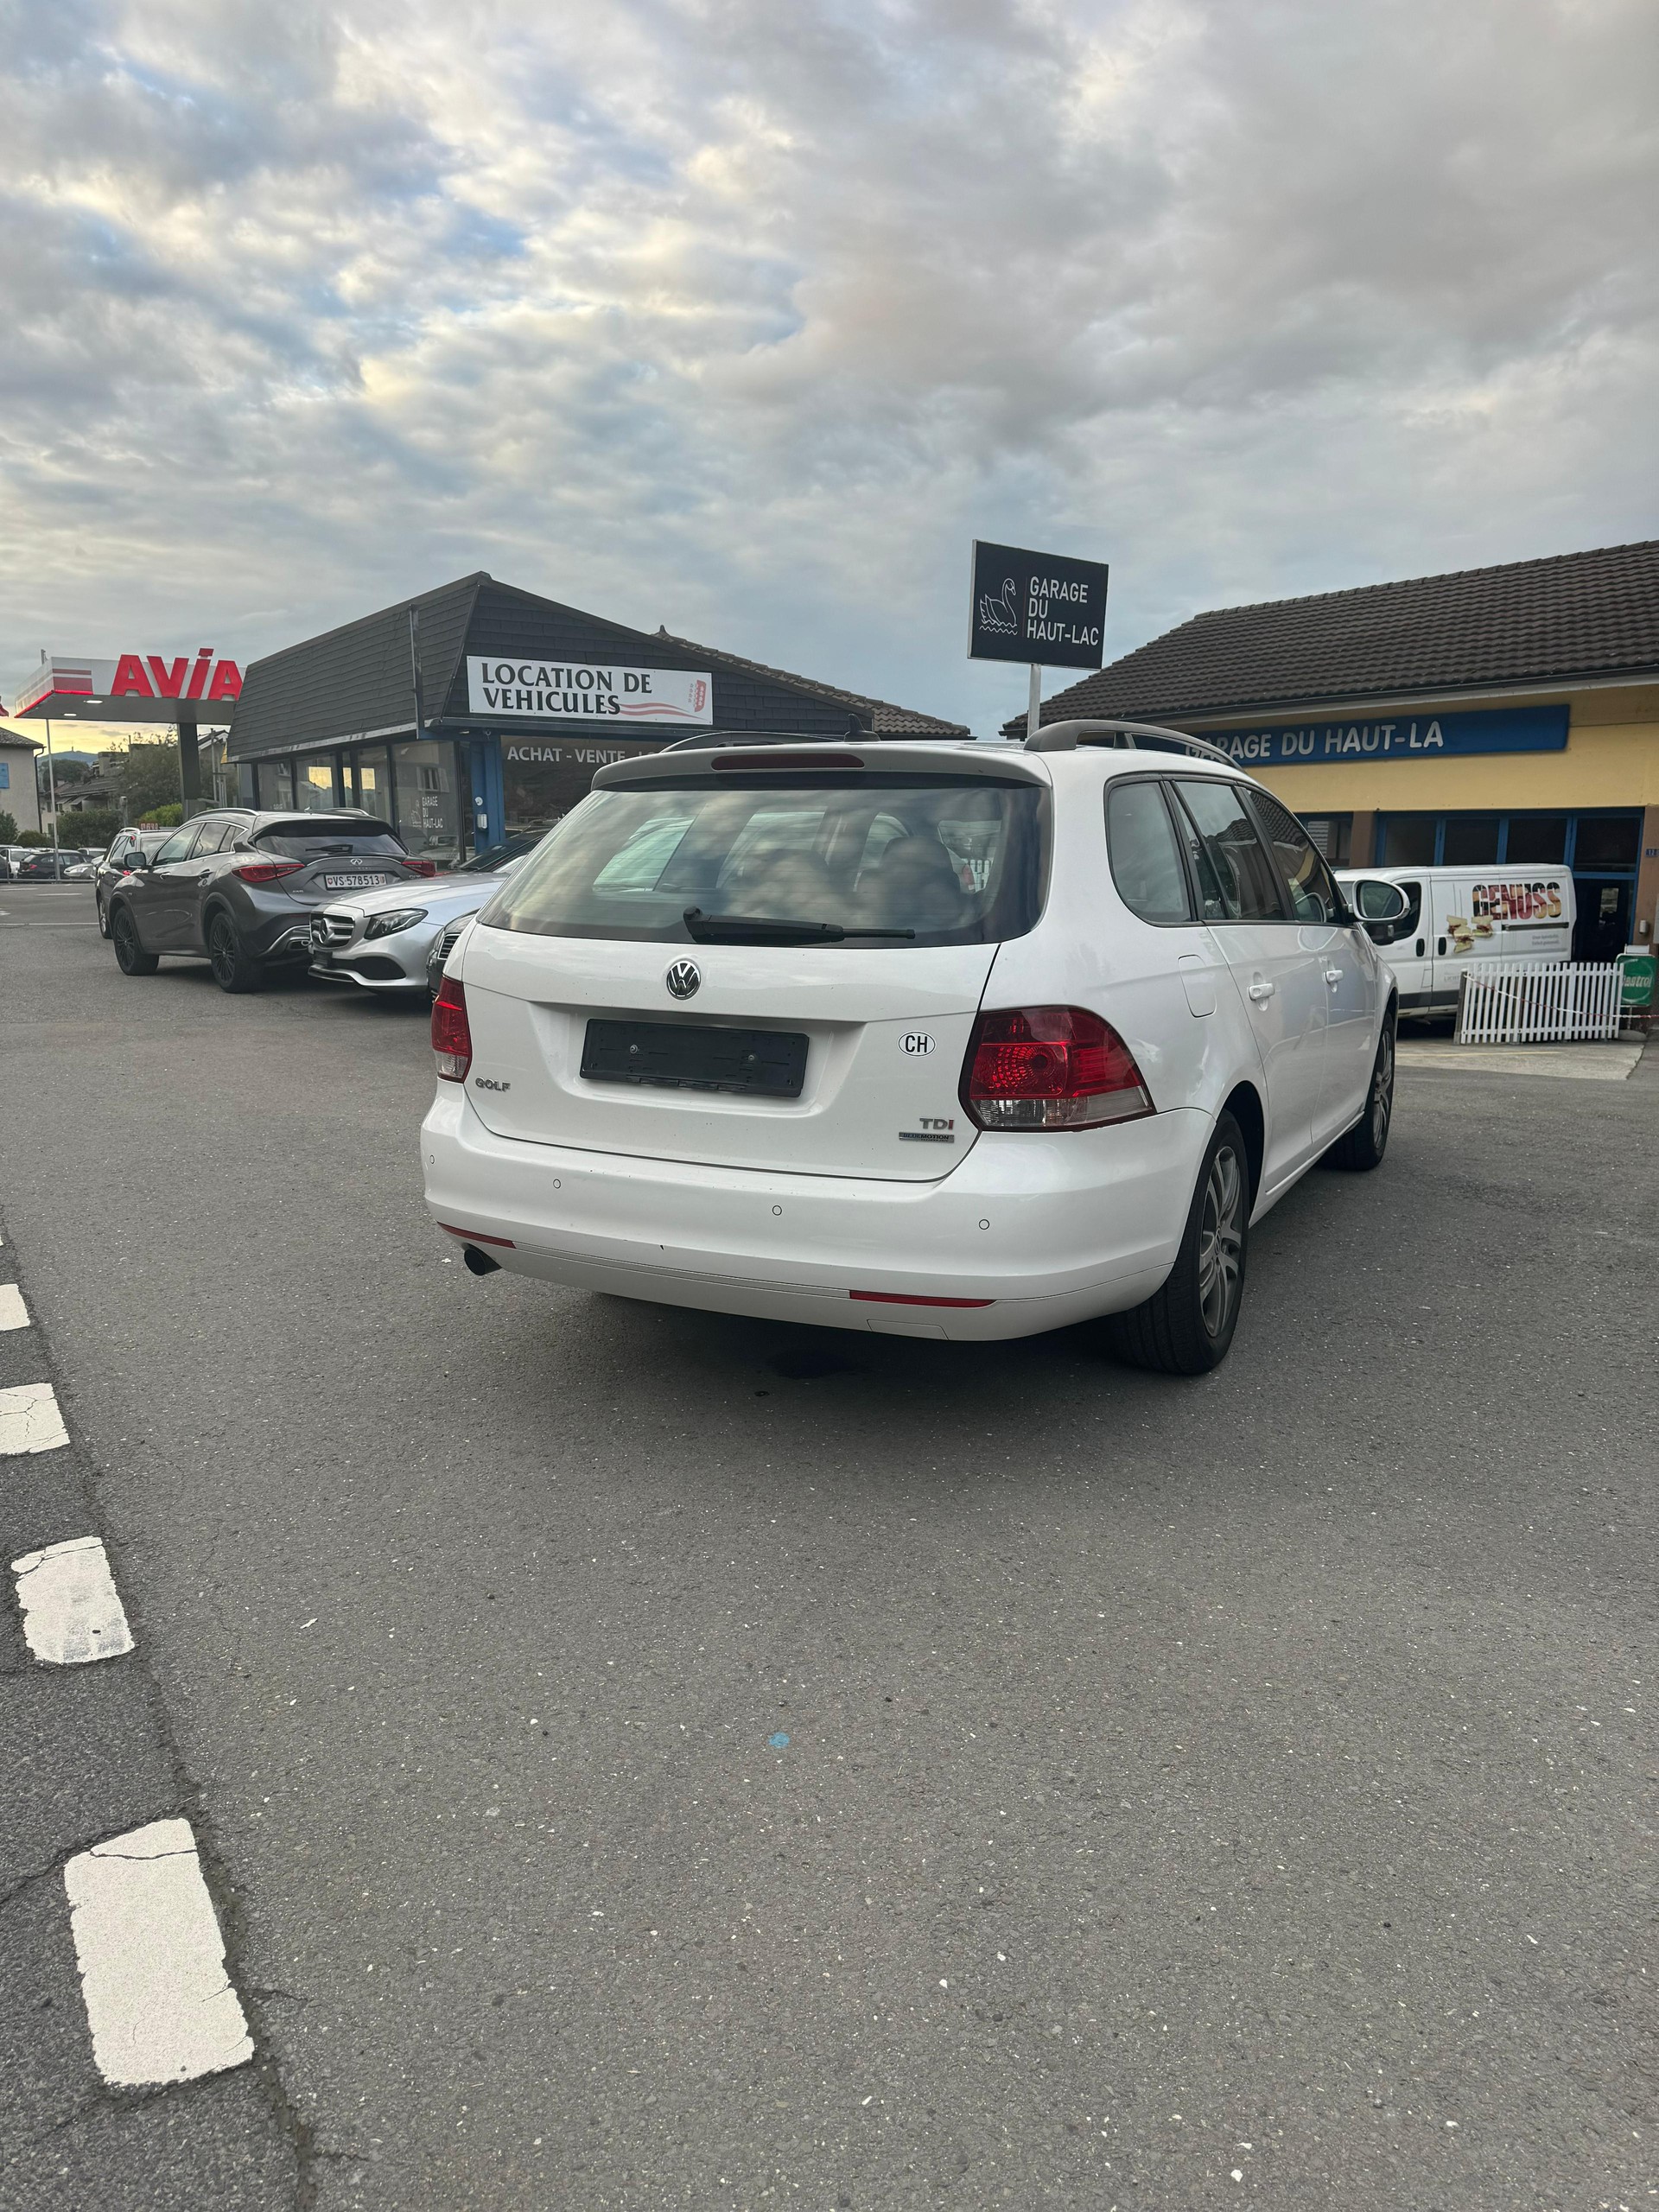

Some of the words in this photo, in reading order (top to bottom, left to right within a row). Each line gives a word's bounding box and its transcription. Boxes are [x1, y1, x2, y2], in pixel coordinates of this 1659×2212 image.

[1030, 575, 1089, 604] GARAGE
[1028, 597, 1048, 619] DU
[1027, 619, 1099, 646] HAUT-LAC
[481, 662, 613, 692] LOCATION
[623, 672, 652, 694] DE
[482, 687, 621, 715] VEHICULES
[1281, 731, 1314, 756] DU
[1325, 721, 1444, 754] HAUT-LA
[506, 746, 563, 762] ACHAT
[575, 748, 626, 764] VENTE
[423, 796, 438, 807] GARAGE
[423, 807, 429, 817] DU
[1472, 881, 1562, 921] GENUSS
[905, 1035, 928, 1053] CH
[475, 1077, 511, 1092] GOLF
[919, 1117, 954, 1130] TDI
